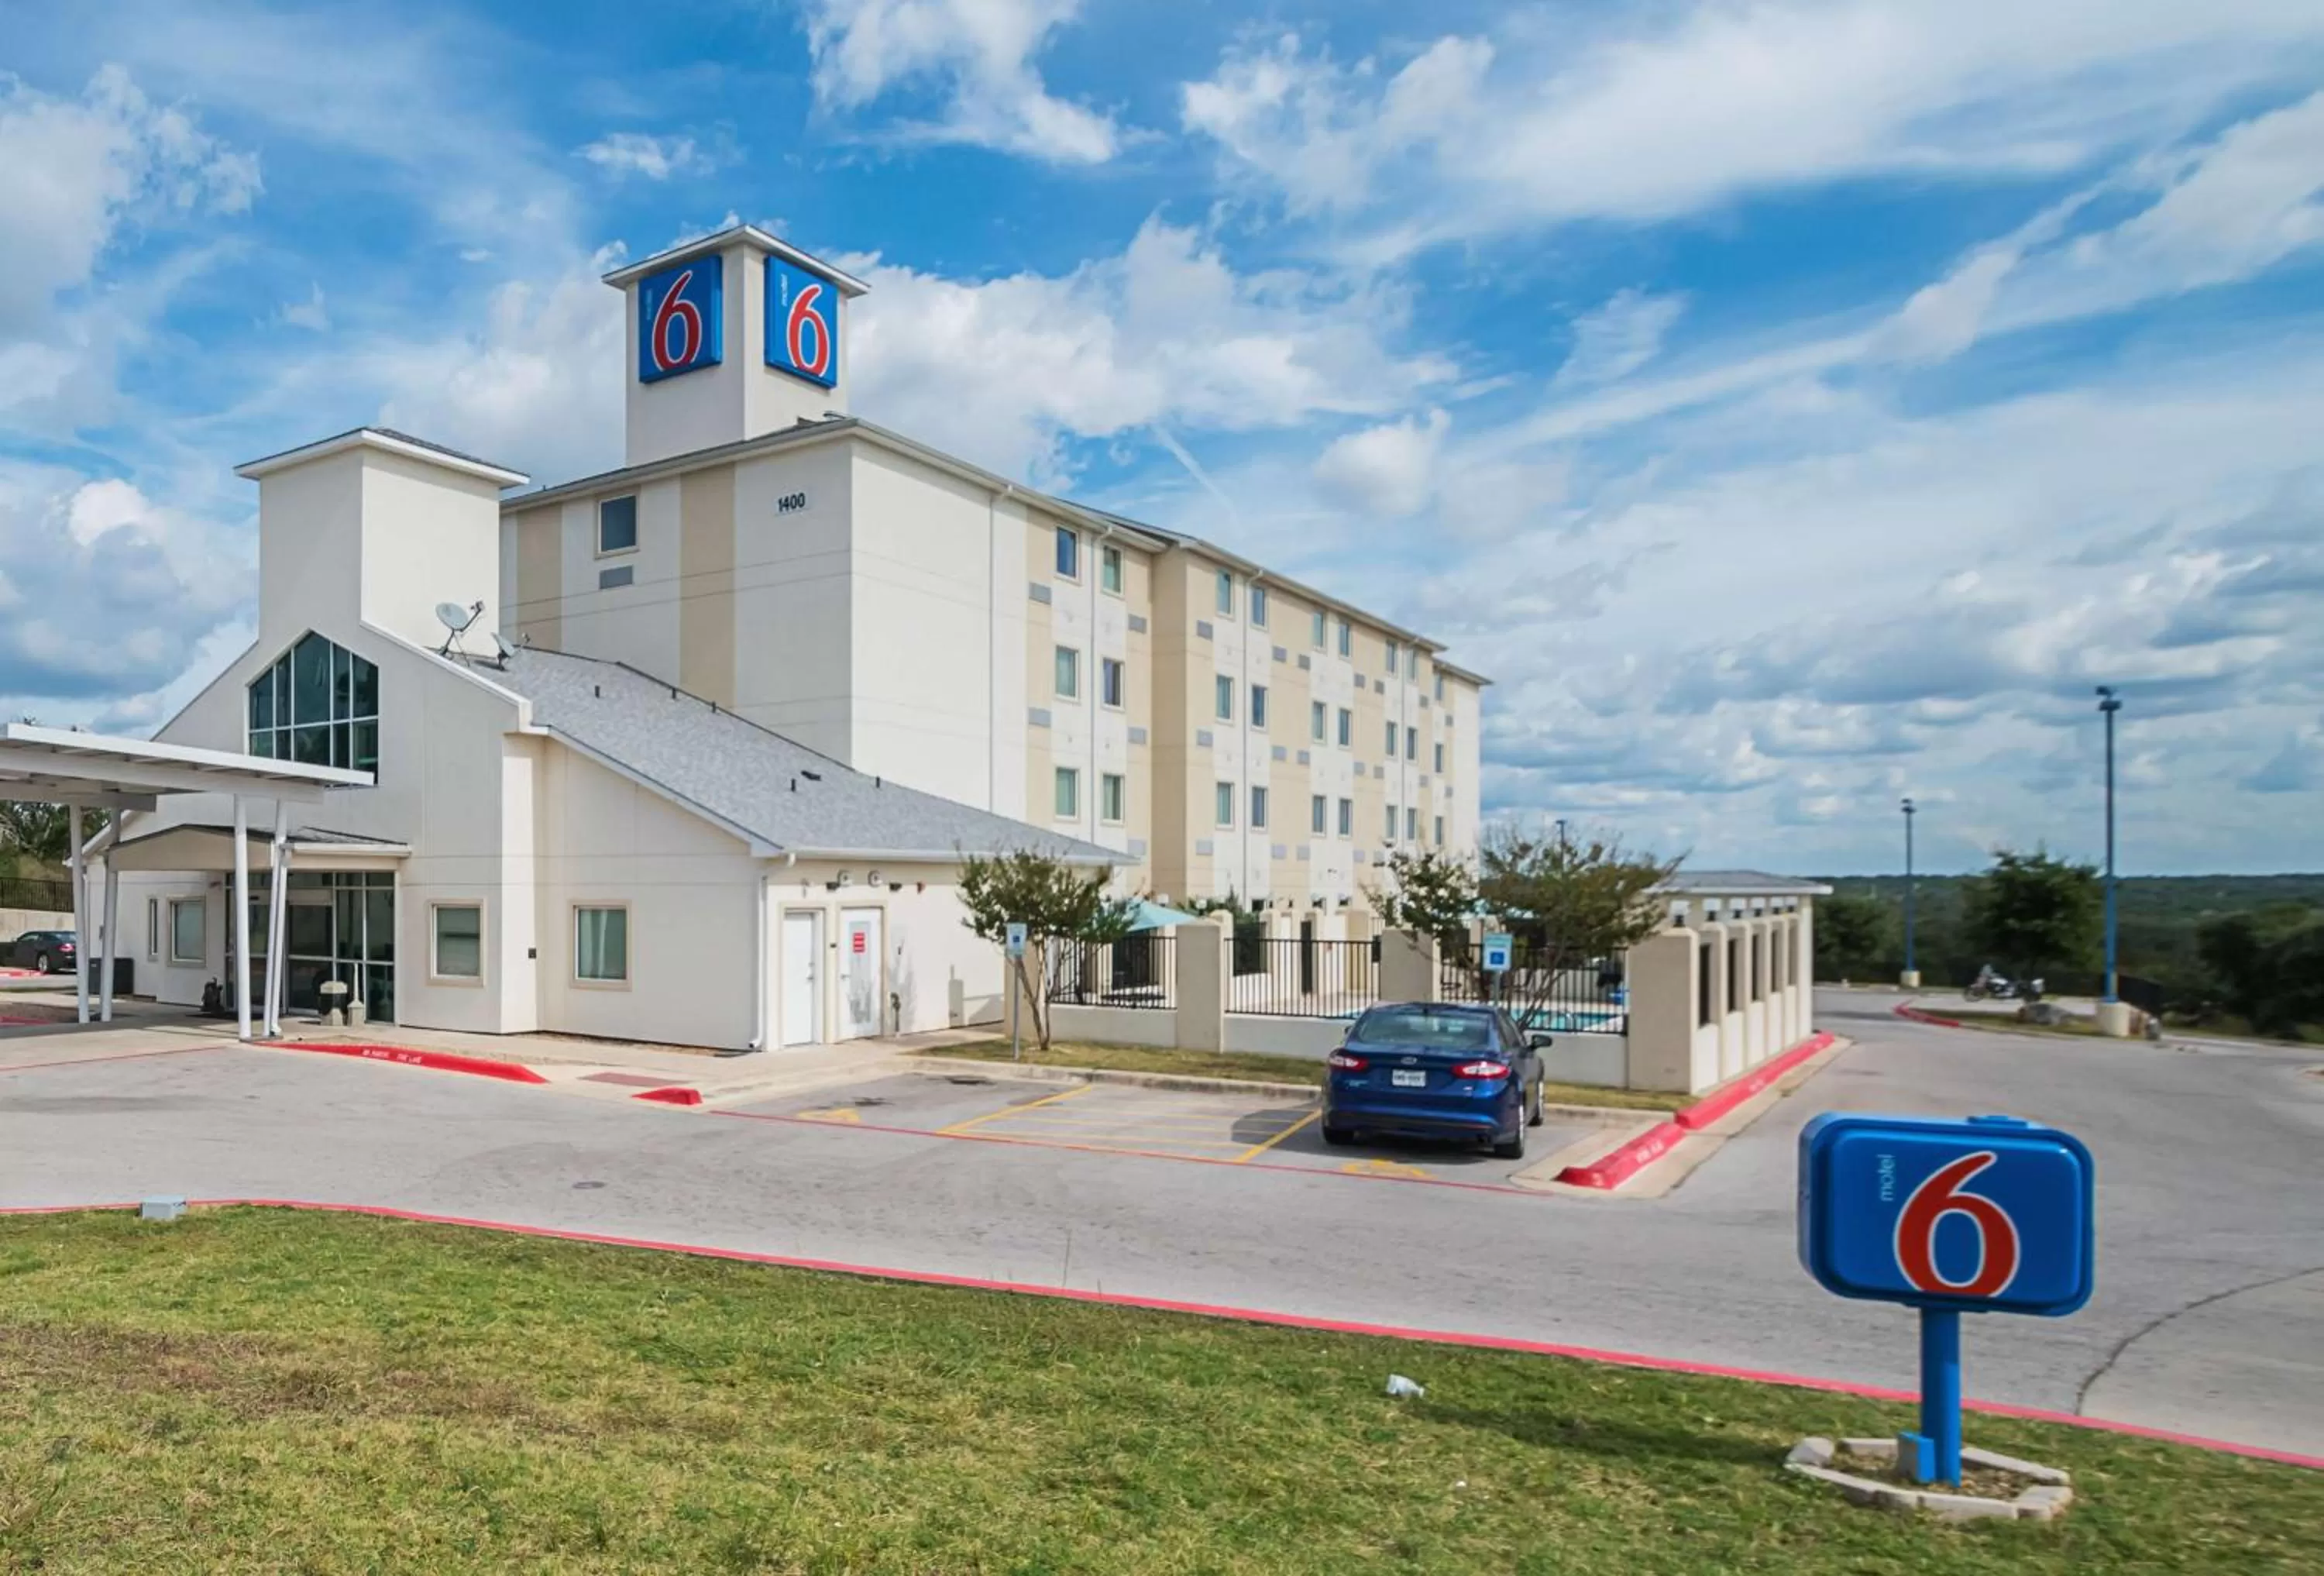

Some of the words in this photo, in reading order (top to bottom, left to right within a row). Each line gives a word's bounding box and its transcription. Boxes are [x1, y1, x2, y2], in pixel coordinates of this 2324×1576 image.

[652, 270, 702, 371] 6
[787, 284, 830, 377] 6
[778, 492, 806, 511] 1400
[1876, 1153, 1895, 1202] motel
[1893, 1150, 2020, 1298] 6
